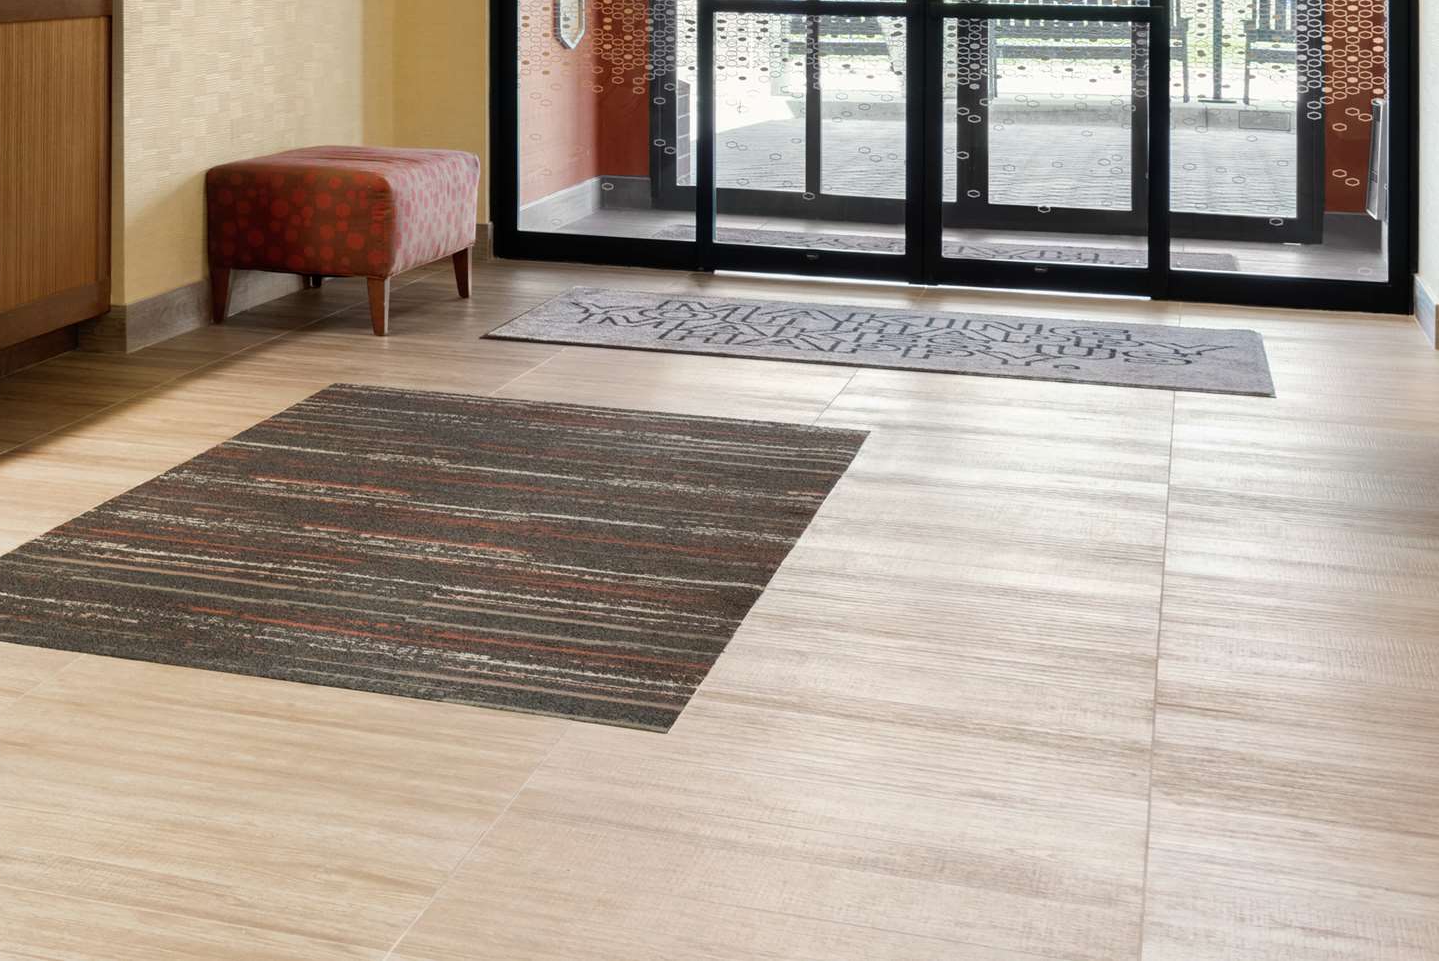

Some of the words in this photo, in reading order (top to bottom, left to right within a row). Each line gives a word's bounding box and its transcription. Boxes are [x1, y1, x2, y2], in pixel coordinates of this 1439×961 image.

[571, 301, 798, 327] YOU
[833, 318, 1234, 356] HAPPY
[578, 314, 990, 354] MAKES
[1036, 343, 1193, 366] US
[655, 300, 1128, 340] MAKING
[656, 329, 1080, 370] HAPPY.
